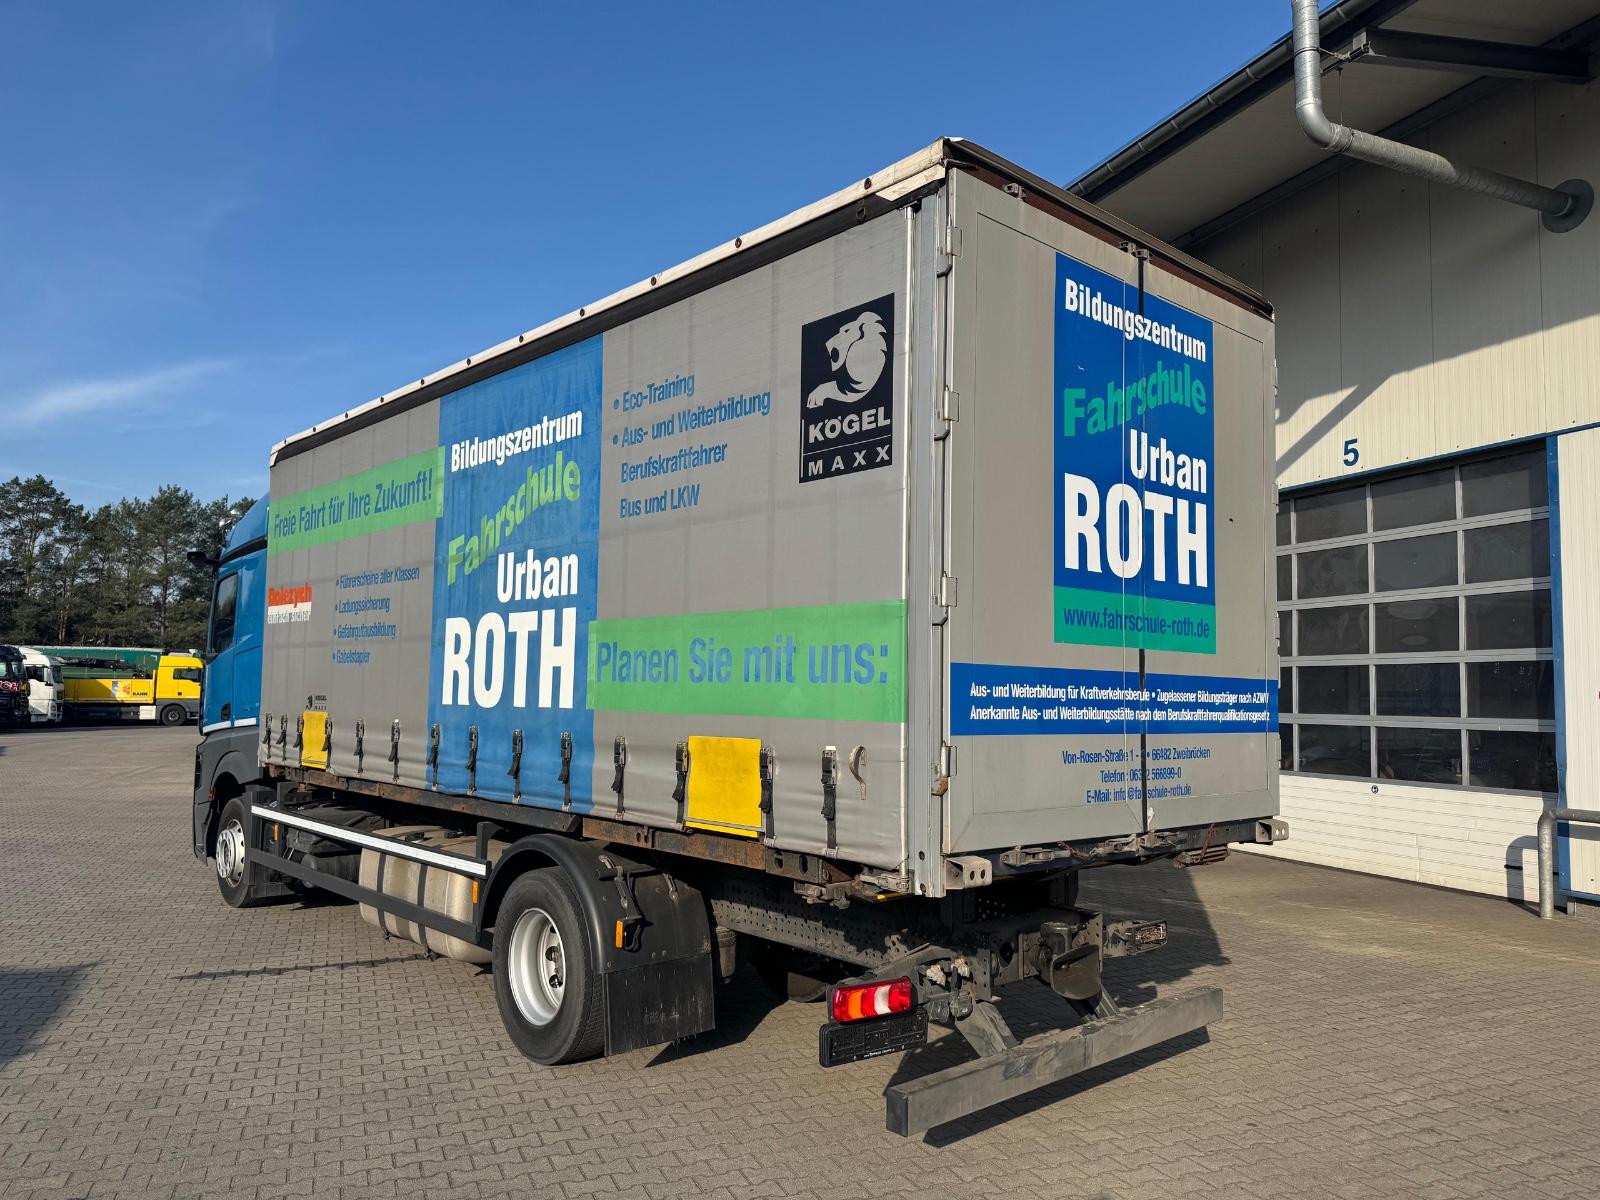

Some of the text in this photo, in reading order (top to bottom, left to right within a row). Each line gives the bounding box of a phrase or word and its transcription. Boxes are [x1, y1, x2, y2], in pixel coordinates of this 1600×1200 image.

[1065, 278, 1206, 362] Bildungszentrum
[622, 374, 695, 412] Eco-Training
[1063, 360, 1207, 437] Fahrschule
[621, 391, 771, 447] Aus- und Weiterbildung
[808, 406, 891, 444] KÖGEL
[451, 410, 583, 473] Bildungszentrum
[1130, 428, 1207, 494] Urban
[1343, 438, 1360, 467] 5
[621, 443, 728, 483] Berufskraftfahrer
[273, 468, 433, 538] Freie Fahrt für Ihre Zukunft!
[447, 451, 581, 586] Fahrschule
[620, 484, 700, 518] Bus und LKW
[1064, 472, 1208, 588] ROTH
[339, 571, 379, 589] Führerscheine
[394, 567, 420, 582] Klassen
[497, 549, 579, 603] Urban
[338, 597, 390, 615] Ladungssicherung
[1063, 607, 1210, 638] www.fahrschule-roth.de
[441, 607, 577, 709] ROTH
[596, 634, 889, 685] Planen Sie mit uns:
[970, 682, 991, 697] Aus-
[992, 684, 1009, 698] und
[1010, 683, 1066, 702] Weiterbildung
[1067, 685, 1079, 700] für
[1157, 689, 1196, 705] Zugelassener
[1197, 691, 1238, 706] Bildungsträger
[1238, 692, 1252, 704] nach
[970, 705, 1020, 720] Anerkannte
[1021, 705, 1042, 720] Aus-
[1043, 706, 1059, 720] und
[1135, 708, 1152, 721] nach
[1152, 708, 1167, 721] dem
[1151, 747, 1172, 761] 66482
[1172, 746, 1211, 761] Zweibrücken
[1129, 768, 1150, 782] 0632
[1086, 788, 1112, 804] E-Mail:
